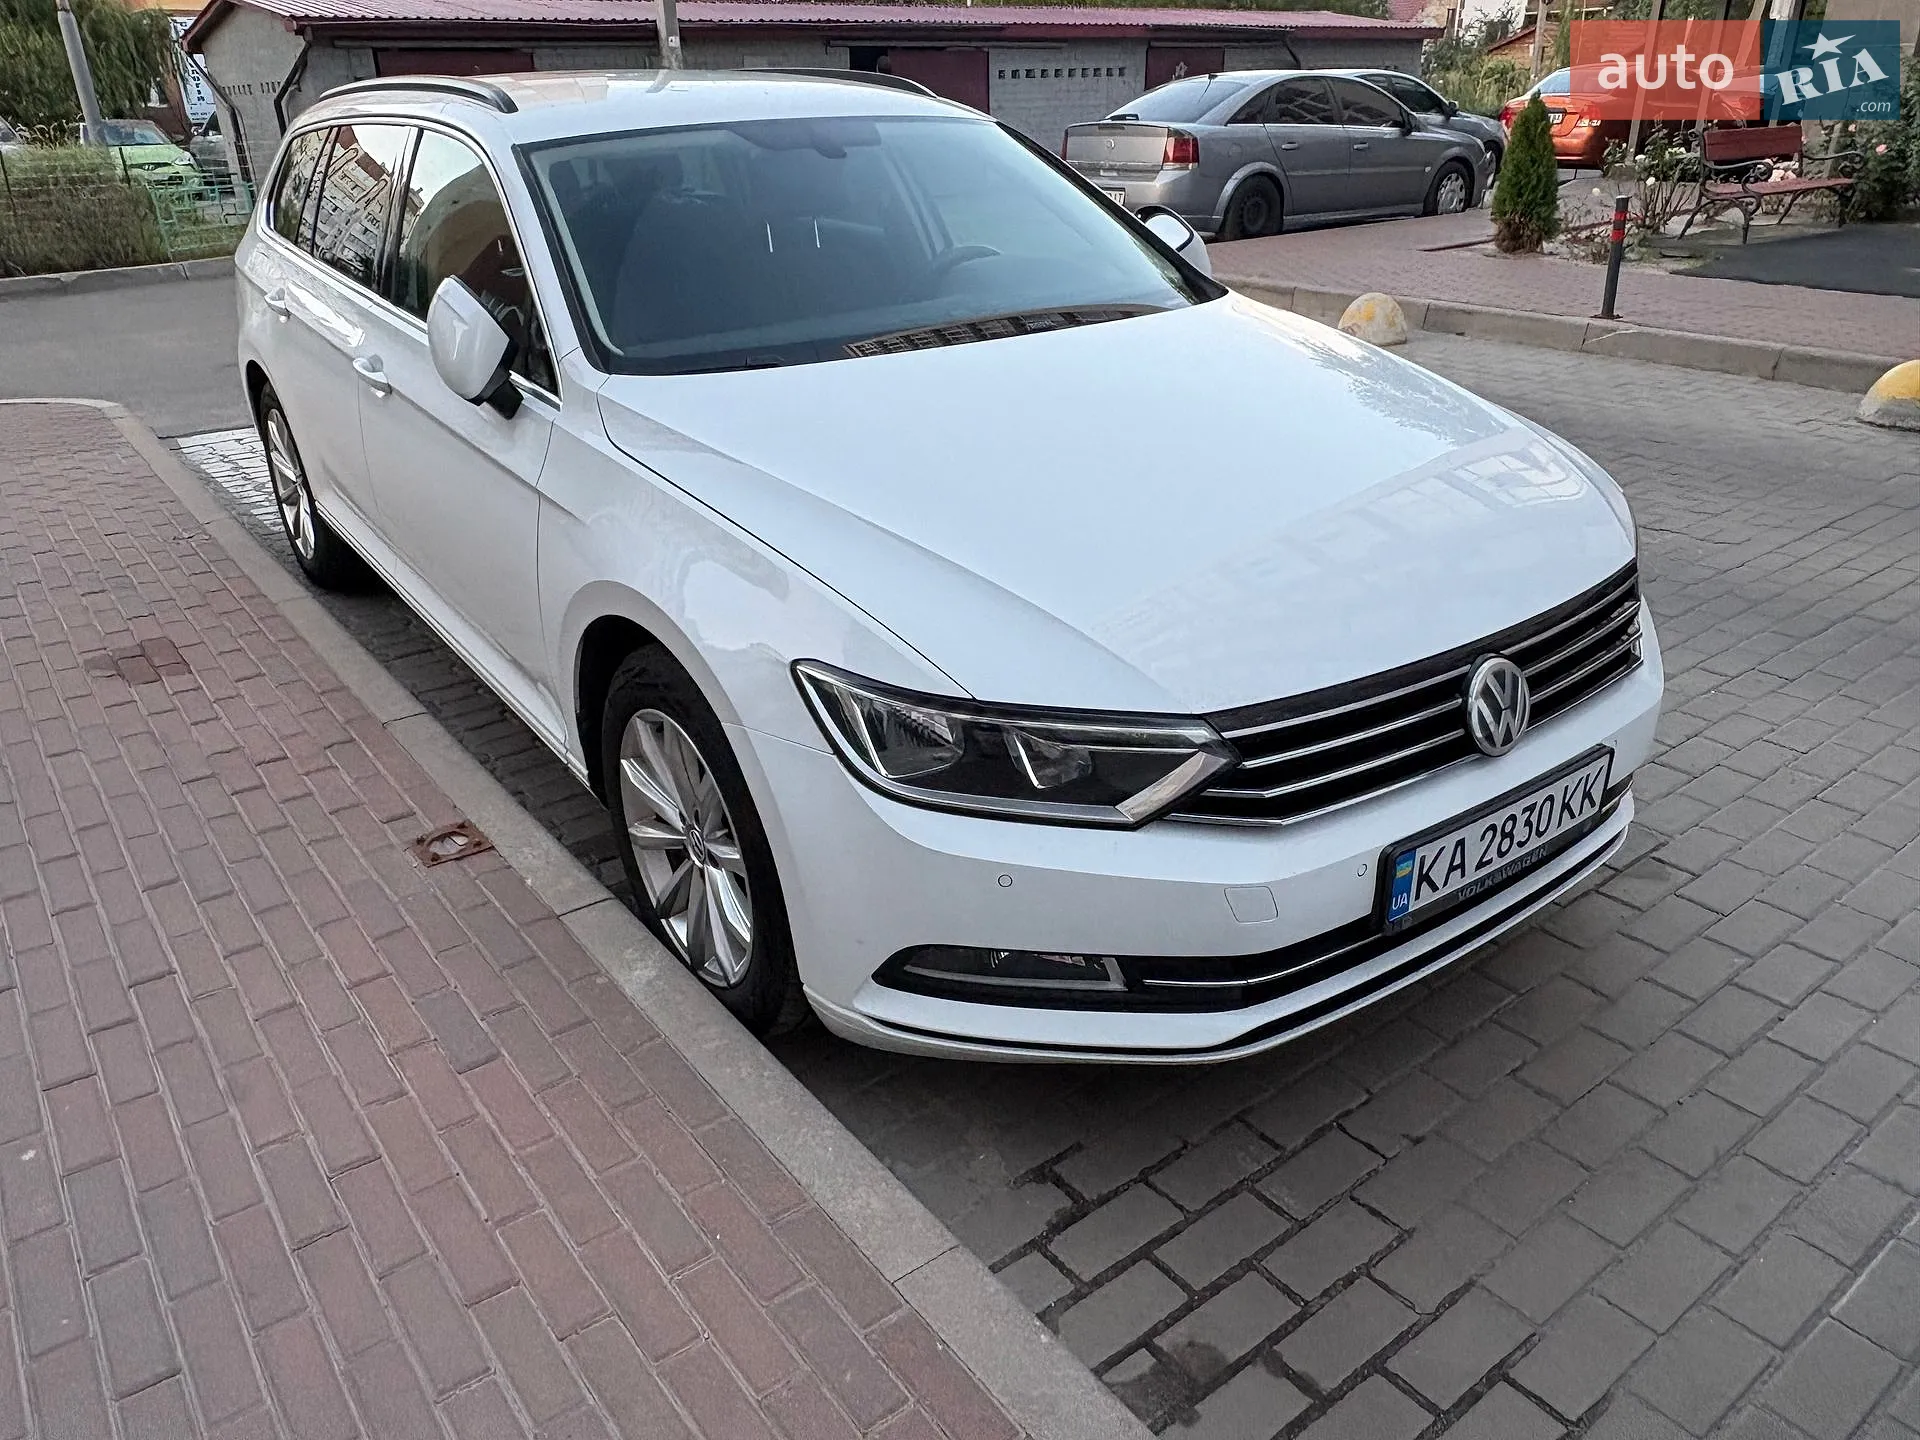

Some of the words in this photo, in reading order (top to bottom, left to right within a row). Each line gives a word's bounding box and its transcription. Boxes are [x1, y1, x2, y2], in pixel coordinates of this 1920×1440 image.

[1415, 836, 1466, 902] KA
[1475, 793, 1555, 873] 2830
[1557, 764, 1605, 829] KK
[1392, 892, 1408, 910] UA
